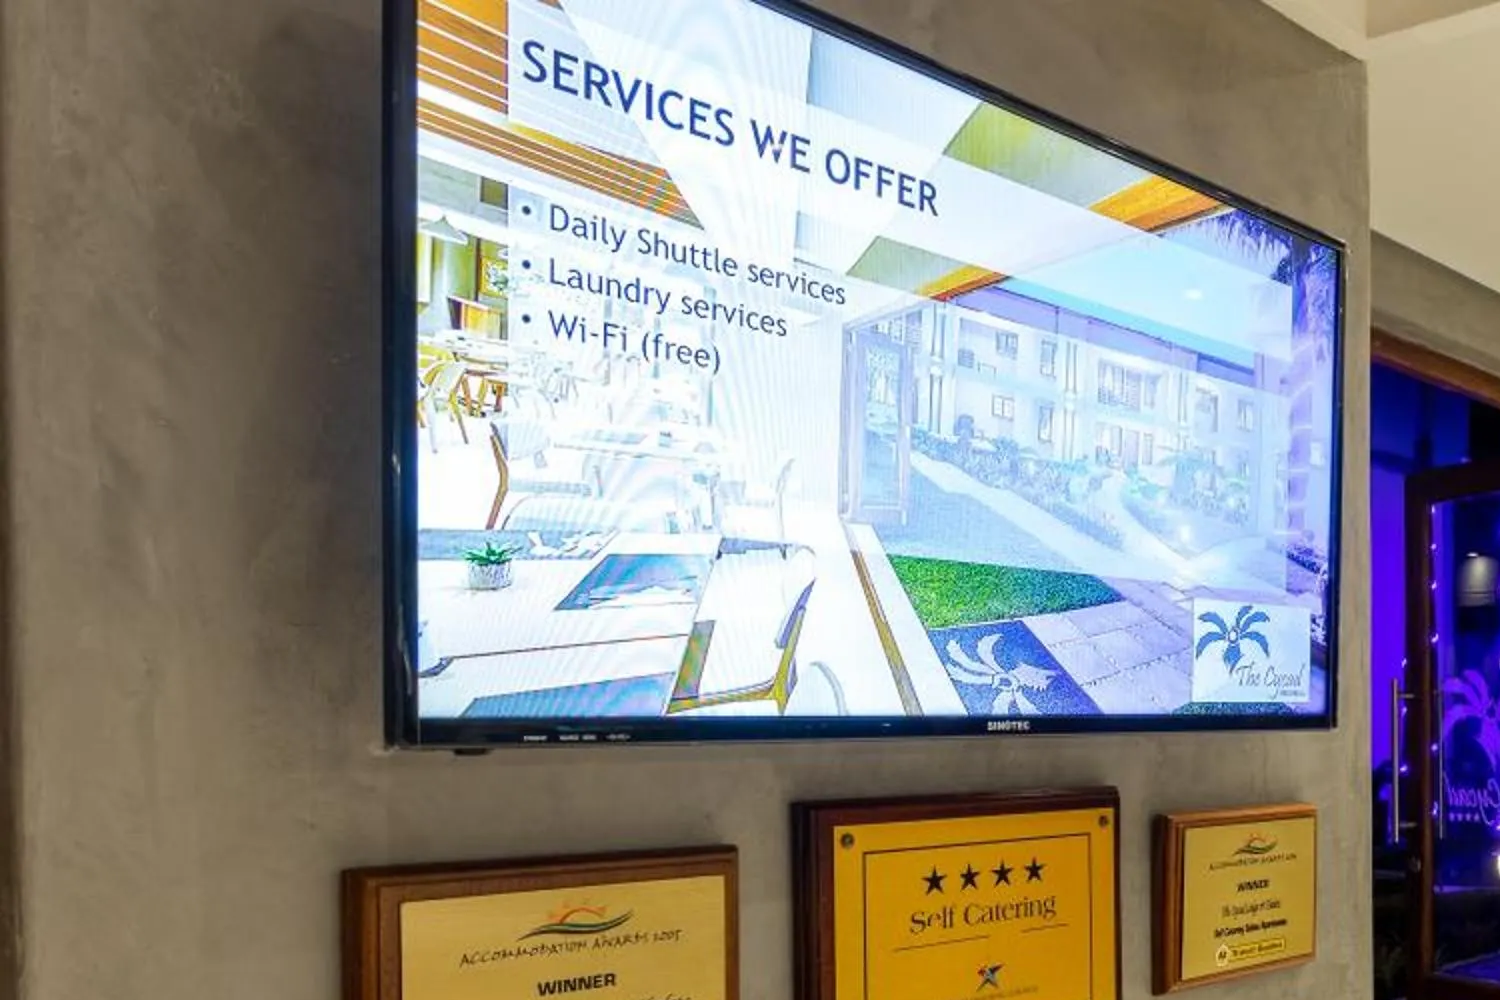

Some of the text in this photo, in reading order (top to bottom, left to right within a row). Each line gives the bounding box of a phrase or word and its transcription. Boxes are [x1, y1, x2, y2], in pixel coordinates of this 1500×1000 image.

[522, 40, 939, 217] SERVICES WE OFFER
[549, 204, 846, 305] Daily Shuttle services
[549, 257, 788, 337] Laundry services
[549, 310, 721, 374] Wi-Fi (free)
[909, 896, 1057, 934] Self Catering
[537, 973, 616, 996] WINNER
